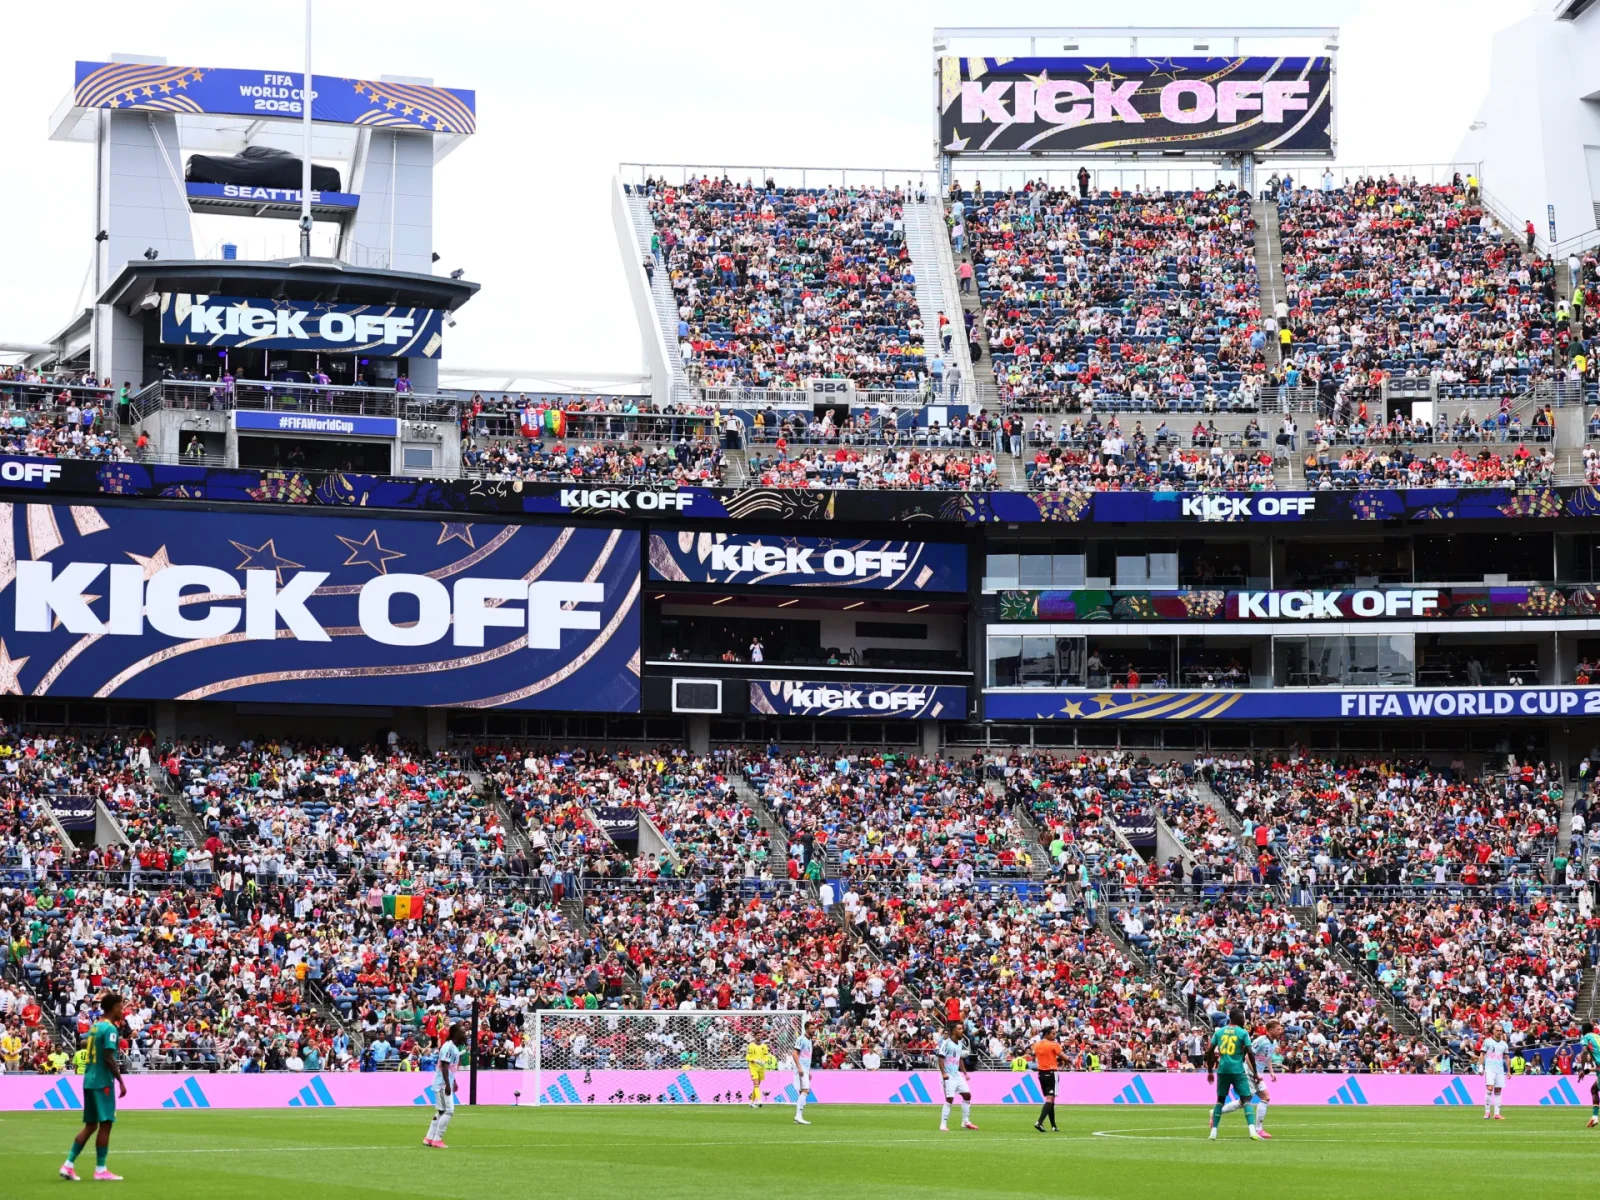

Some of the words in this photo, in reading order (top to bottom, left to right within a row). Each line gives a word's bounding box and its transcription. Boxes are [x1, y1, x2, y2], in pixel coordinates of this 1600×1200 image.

[264, 74, 293, 87] FIFA
[239, 86, 289, 99] WORLD
[961, 80, 1145, 123] KICK
[1159, 80, 1310, 124] OFF
[254, 99, 302, 113] 2026
[191, 305, 310, 340] KICK
[319, 312, 414, 345] OFF
[813, 383, 848, 393] 324
[1388, 378, 1431, 392] 326
[279, 416, 354, 433] #FIFAWorldCup
[1, 461, 62, 483] OFF
[560, 489, 631, 509] KICK
[636, 491, 693, 511] OFF
[1182, 497, 1253, 516] KICK
[1257, 497, 1316, 516] OFF
[711, 543, 816, 575] KICK
[823, 548, 908, 578] OFF
[15, 559, 333, 642] KICK
[358, 572, 605, 650] OFF
[1238, 591, 1344, 618] KICK
[1351, 590, 1439, 617] OFF
[792, 688, 864, 709] KICK
[868, 691, 926, 711] OFF
[1341, 694, 1404, 716] FIFA
[1407, 692, 1515, 716] WORLD
[1519, 692, 1578, 714] CUP
[73, 809, 94, 817] OFF
[1220, 1034, 1238, 1055] 26
